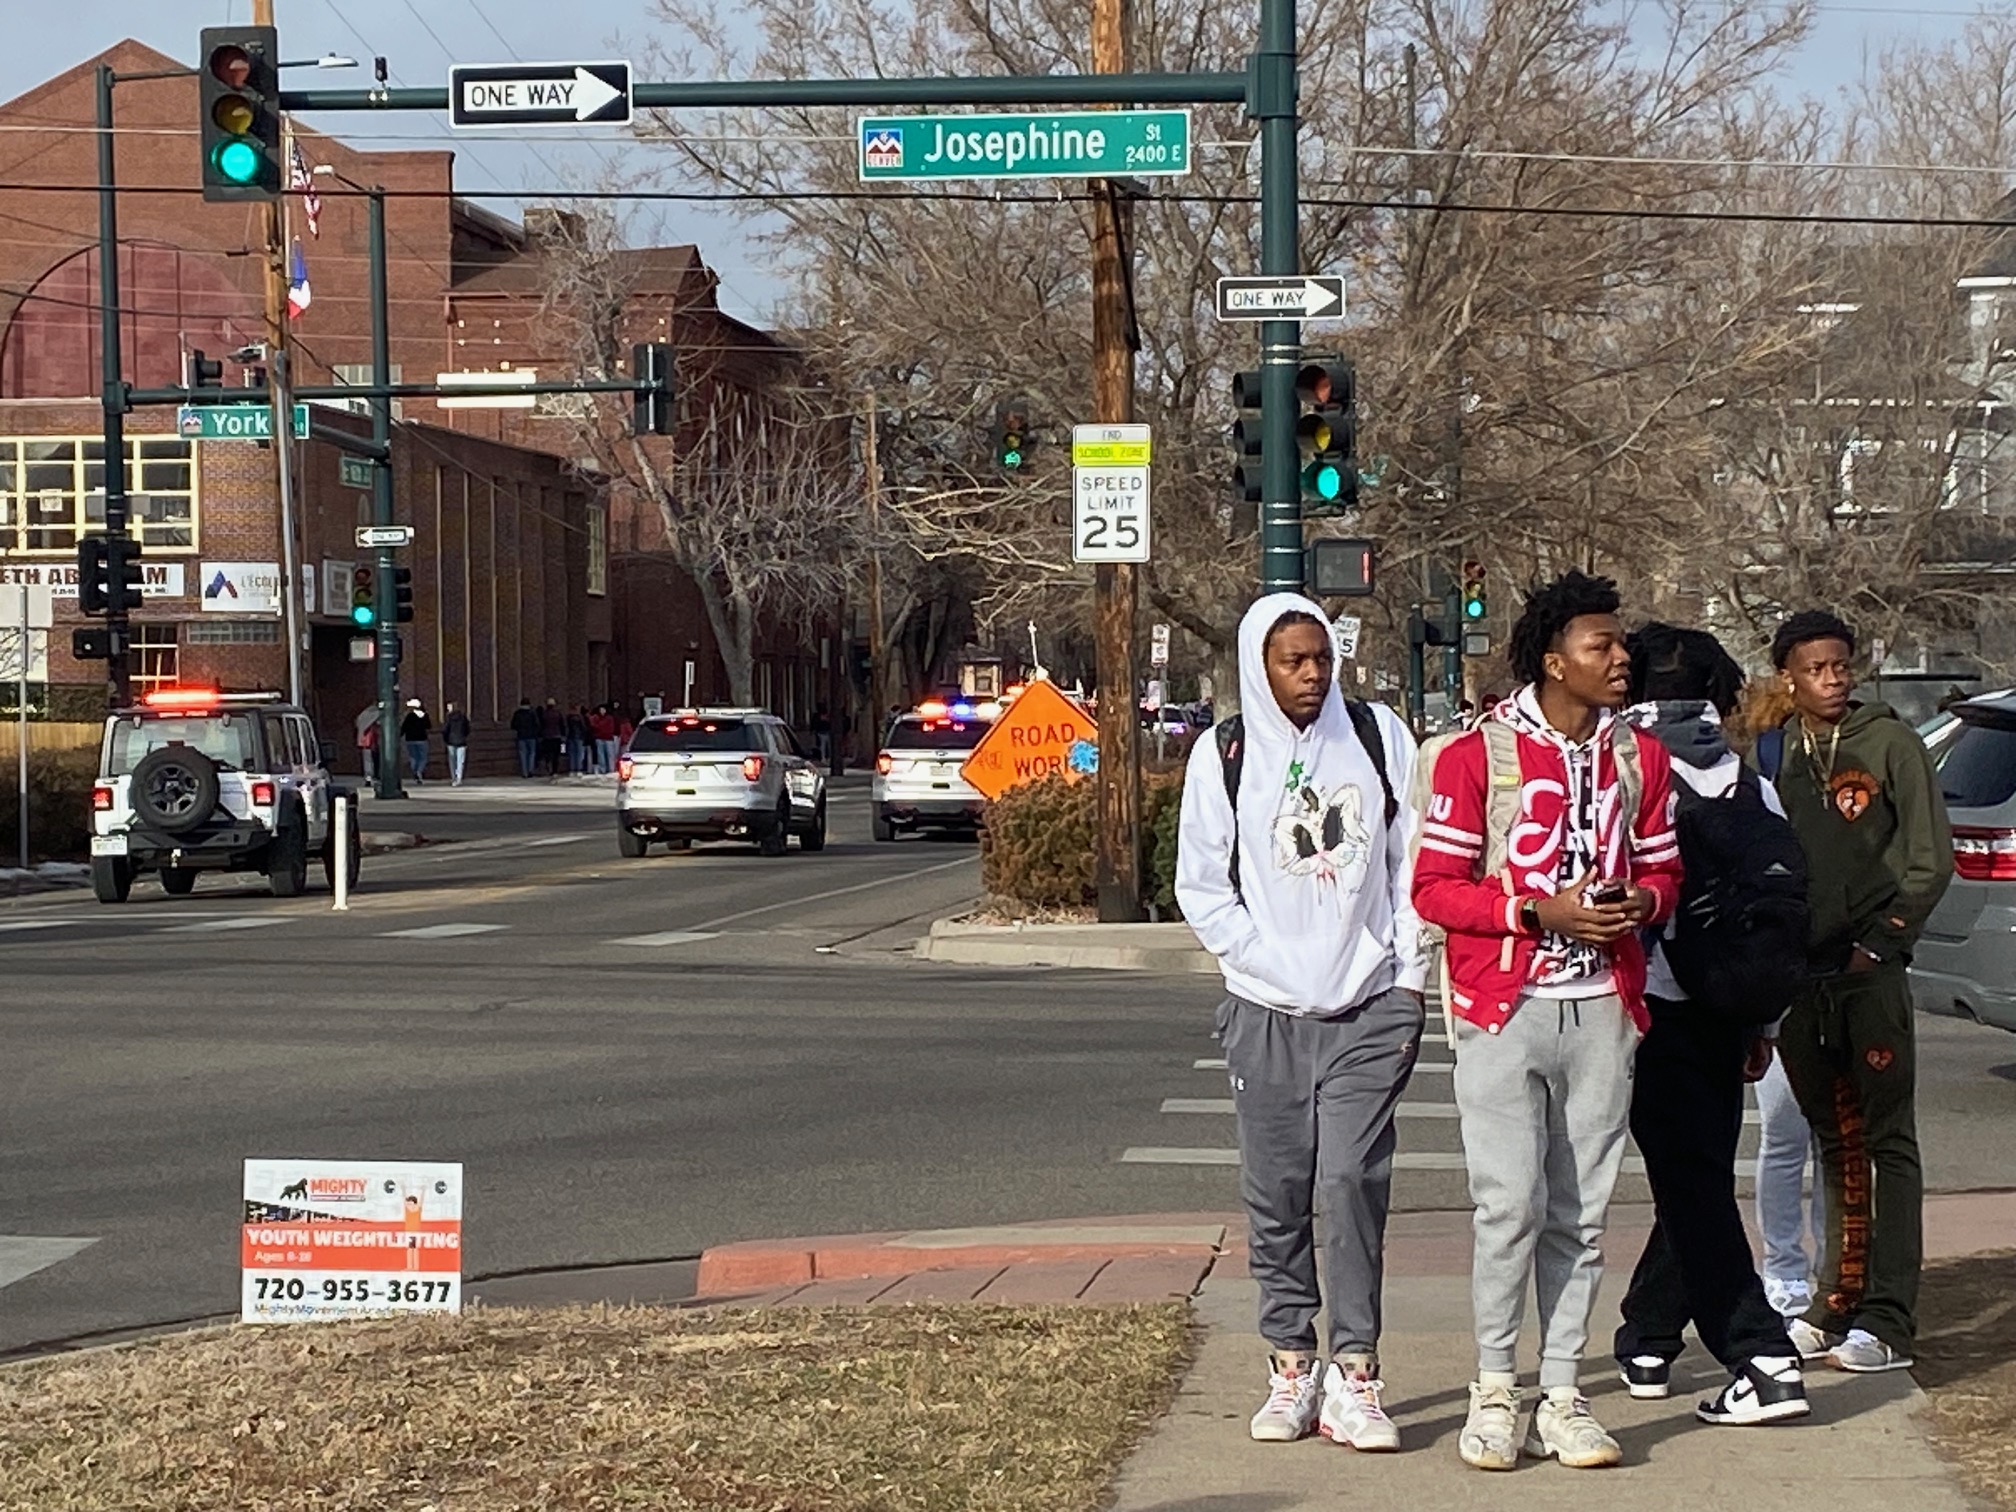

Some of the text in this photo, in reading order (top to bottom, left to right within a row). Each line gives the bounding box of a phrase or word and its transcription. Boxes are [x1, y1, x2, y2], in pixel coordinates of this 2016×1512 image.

[471, 83, 575, 108] ONE WAY
[1145, 123, 1162, 142] St
[923, 122, 1107, 170] Josephine
[1124, 144, 1182, 164] 2400 E
[1232, 290, 1305, 308] ONE WAY
[211, 411, 270, 435] York
[1081, 476, 1143, 492] SPEED
[1087, 496, 1136, 511] LIMIT
[1082, 515, 1140, 549] 25
[1010, 723, 1076, 748] ROAD
[310, 1178, 367, 1195] MIGHTY
[246, 1229, 460, 1249] YOUTH WEIGHTLIFTING
[253, 1251, 285, 1264] Ages
[254, 1277, 452, 1303] 720-955-3677
